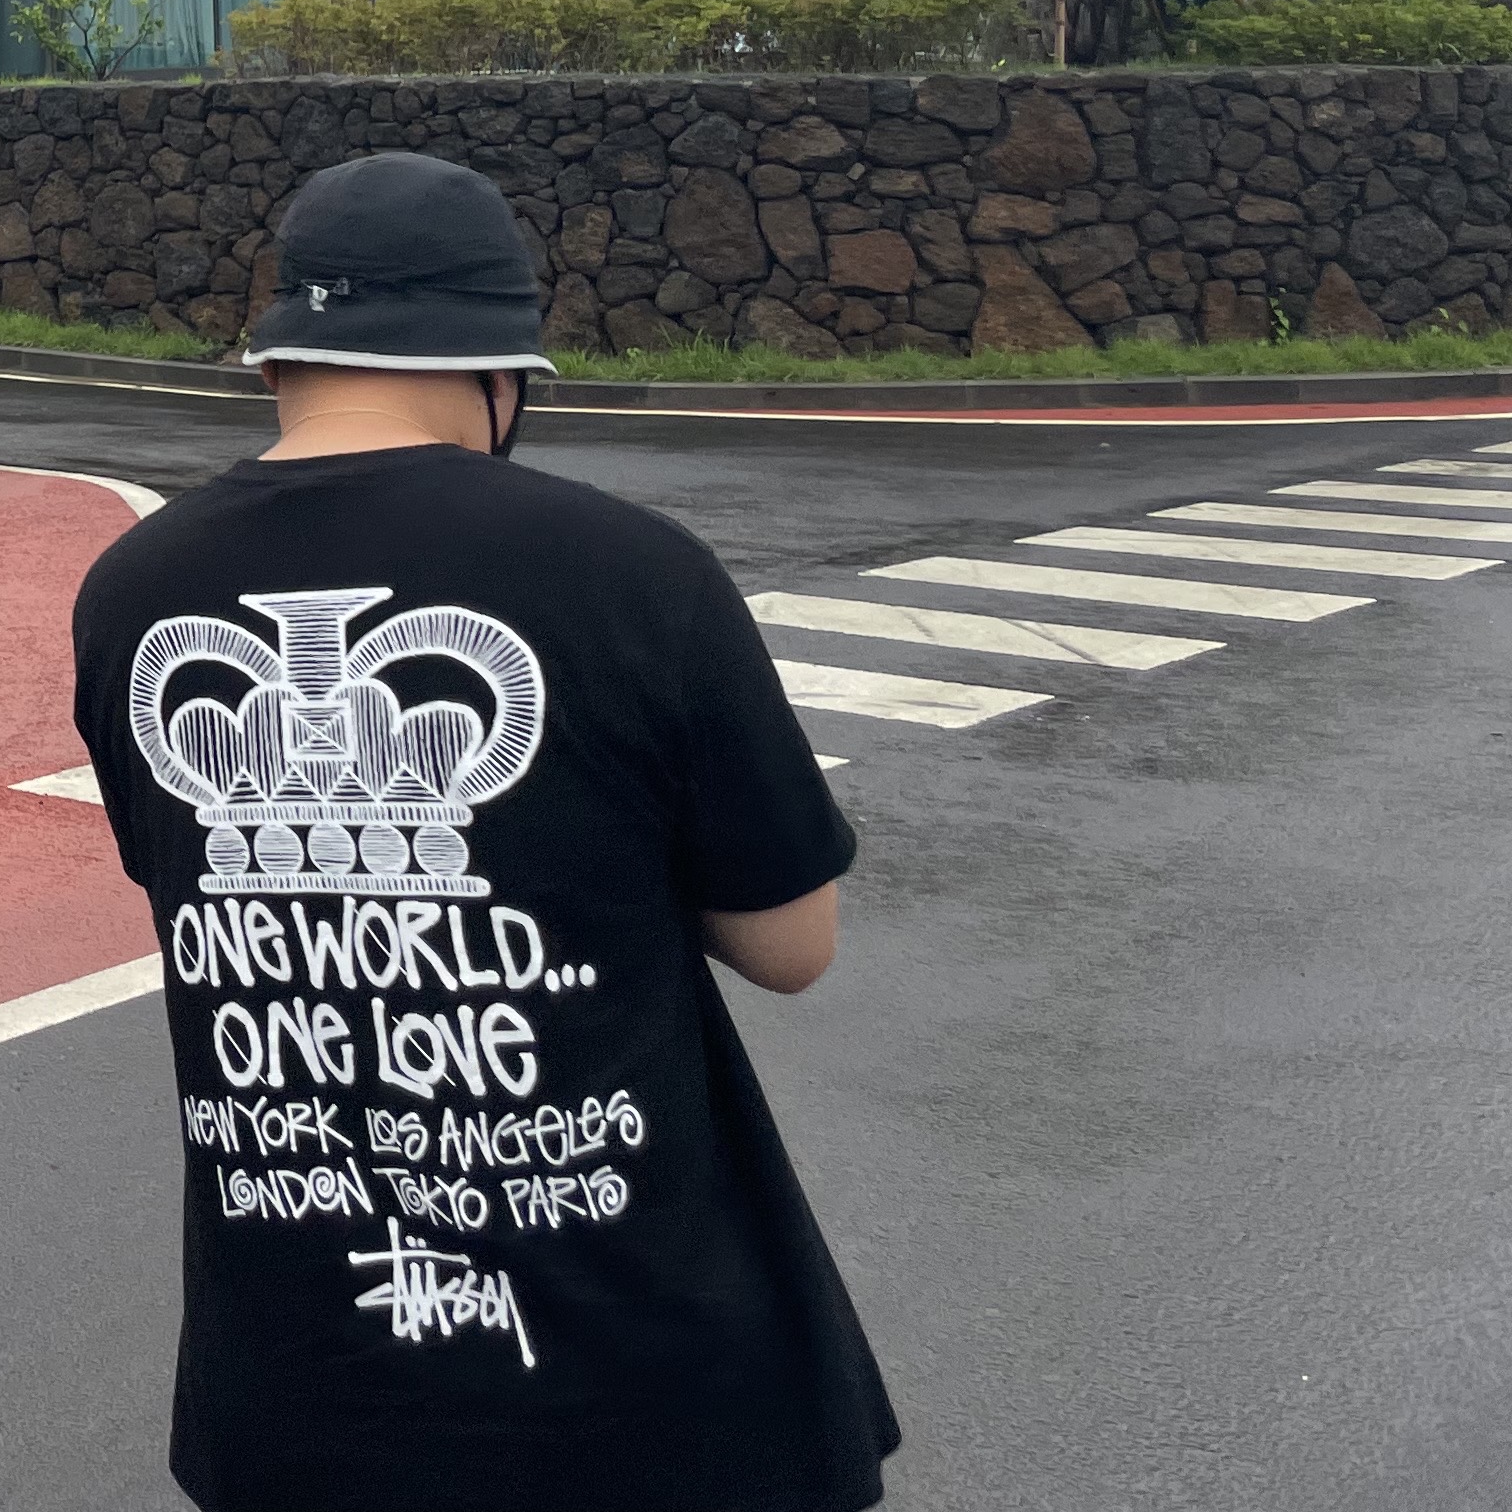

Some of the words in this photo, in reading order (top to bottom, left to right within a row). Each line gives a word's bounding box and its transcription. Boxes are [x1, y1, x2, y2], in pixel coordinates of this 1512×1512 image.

[290, 895, 596, 993] WORLD...
[234, 1095, 354, 1157] YORK
[365, 1106, 429, 1162] LOS
[216, 1156, 375, 1220] LONDON
[371, 1166, 489, 1232] TOKYO
[500, 1164, 629, 1230] PARIS
